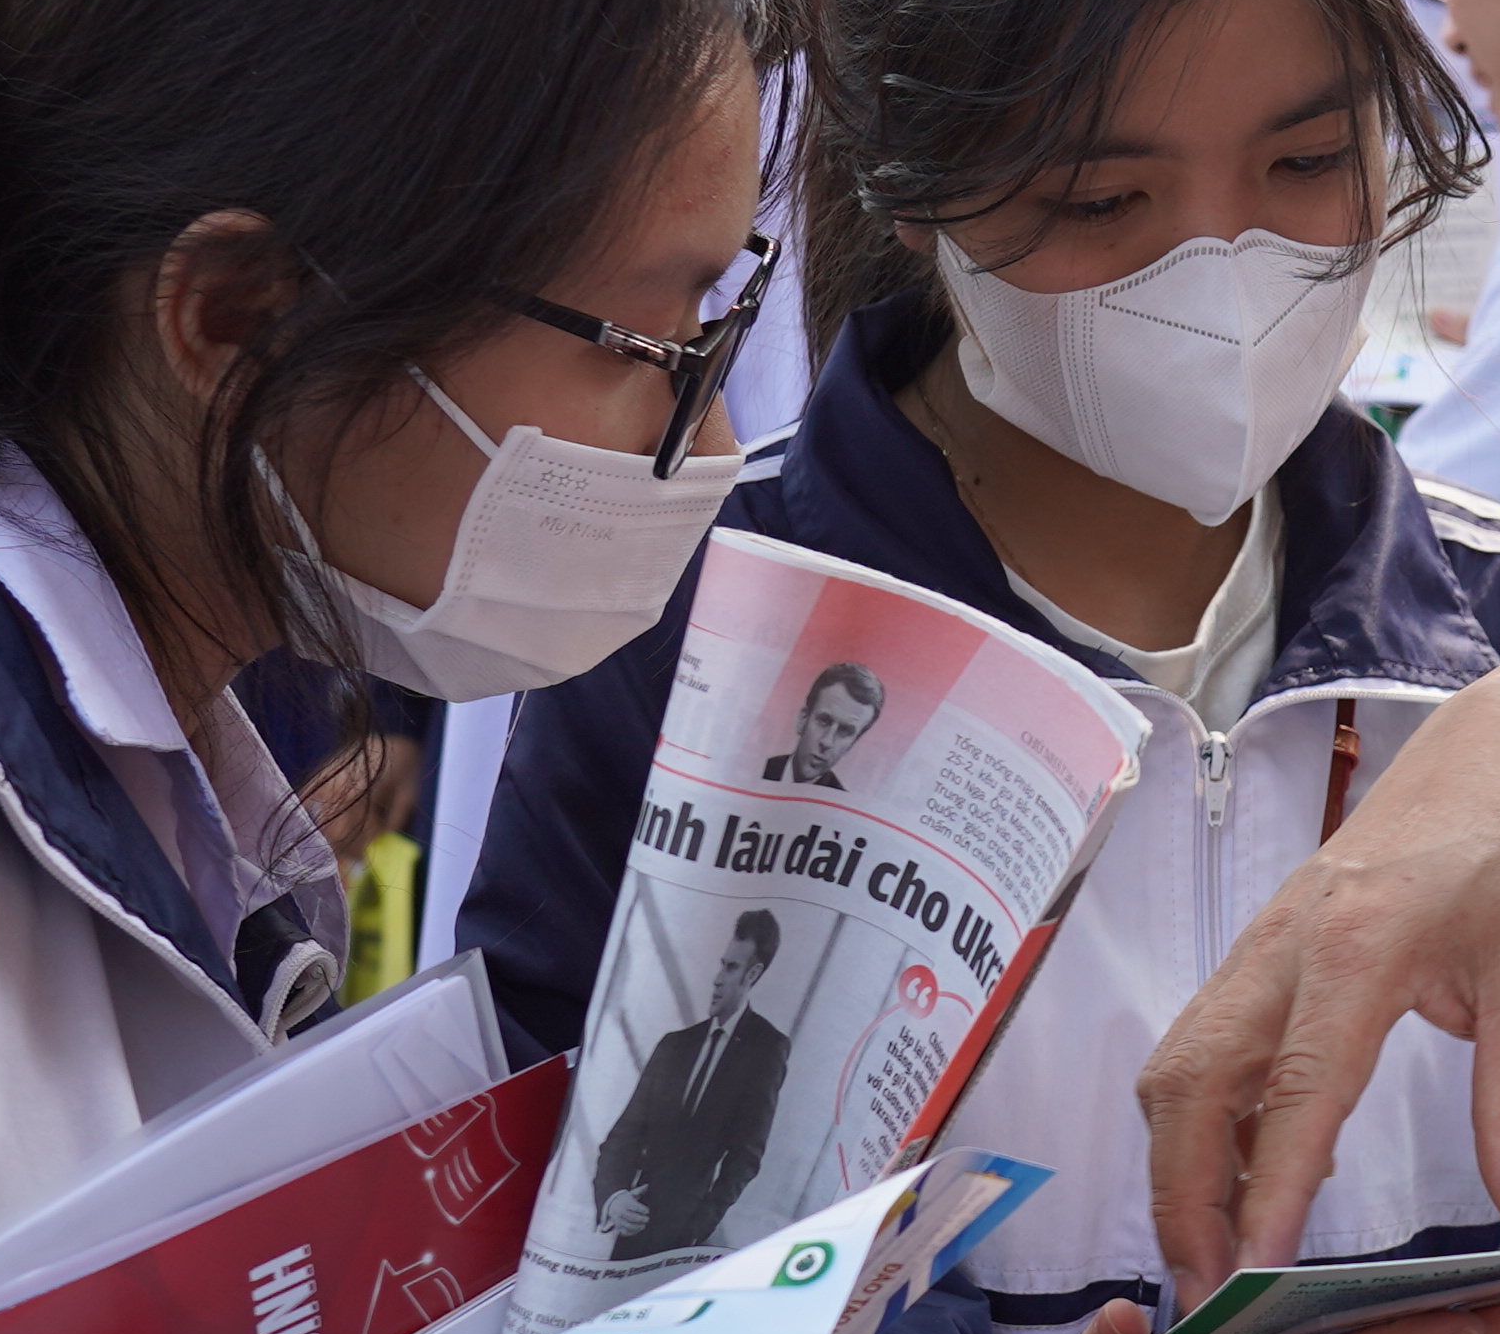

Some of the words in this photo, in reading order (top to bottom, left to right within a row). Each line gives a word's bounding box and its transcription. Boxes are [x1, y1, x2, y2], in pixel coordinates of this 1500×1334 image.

[940, 768, 962, 786] cho
[934, 781, 966, 810] Trung
[635, 788, 706, 862] ình
[714, 814, 785, 874] lâu
[785, 824, 867, 888] dài
[868, 859, 949, 932] cho
